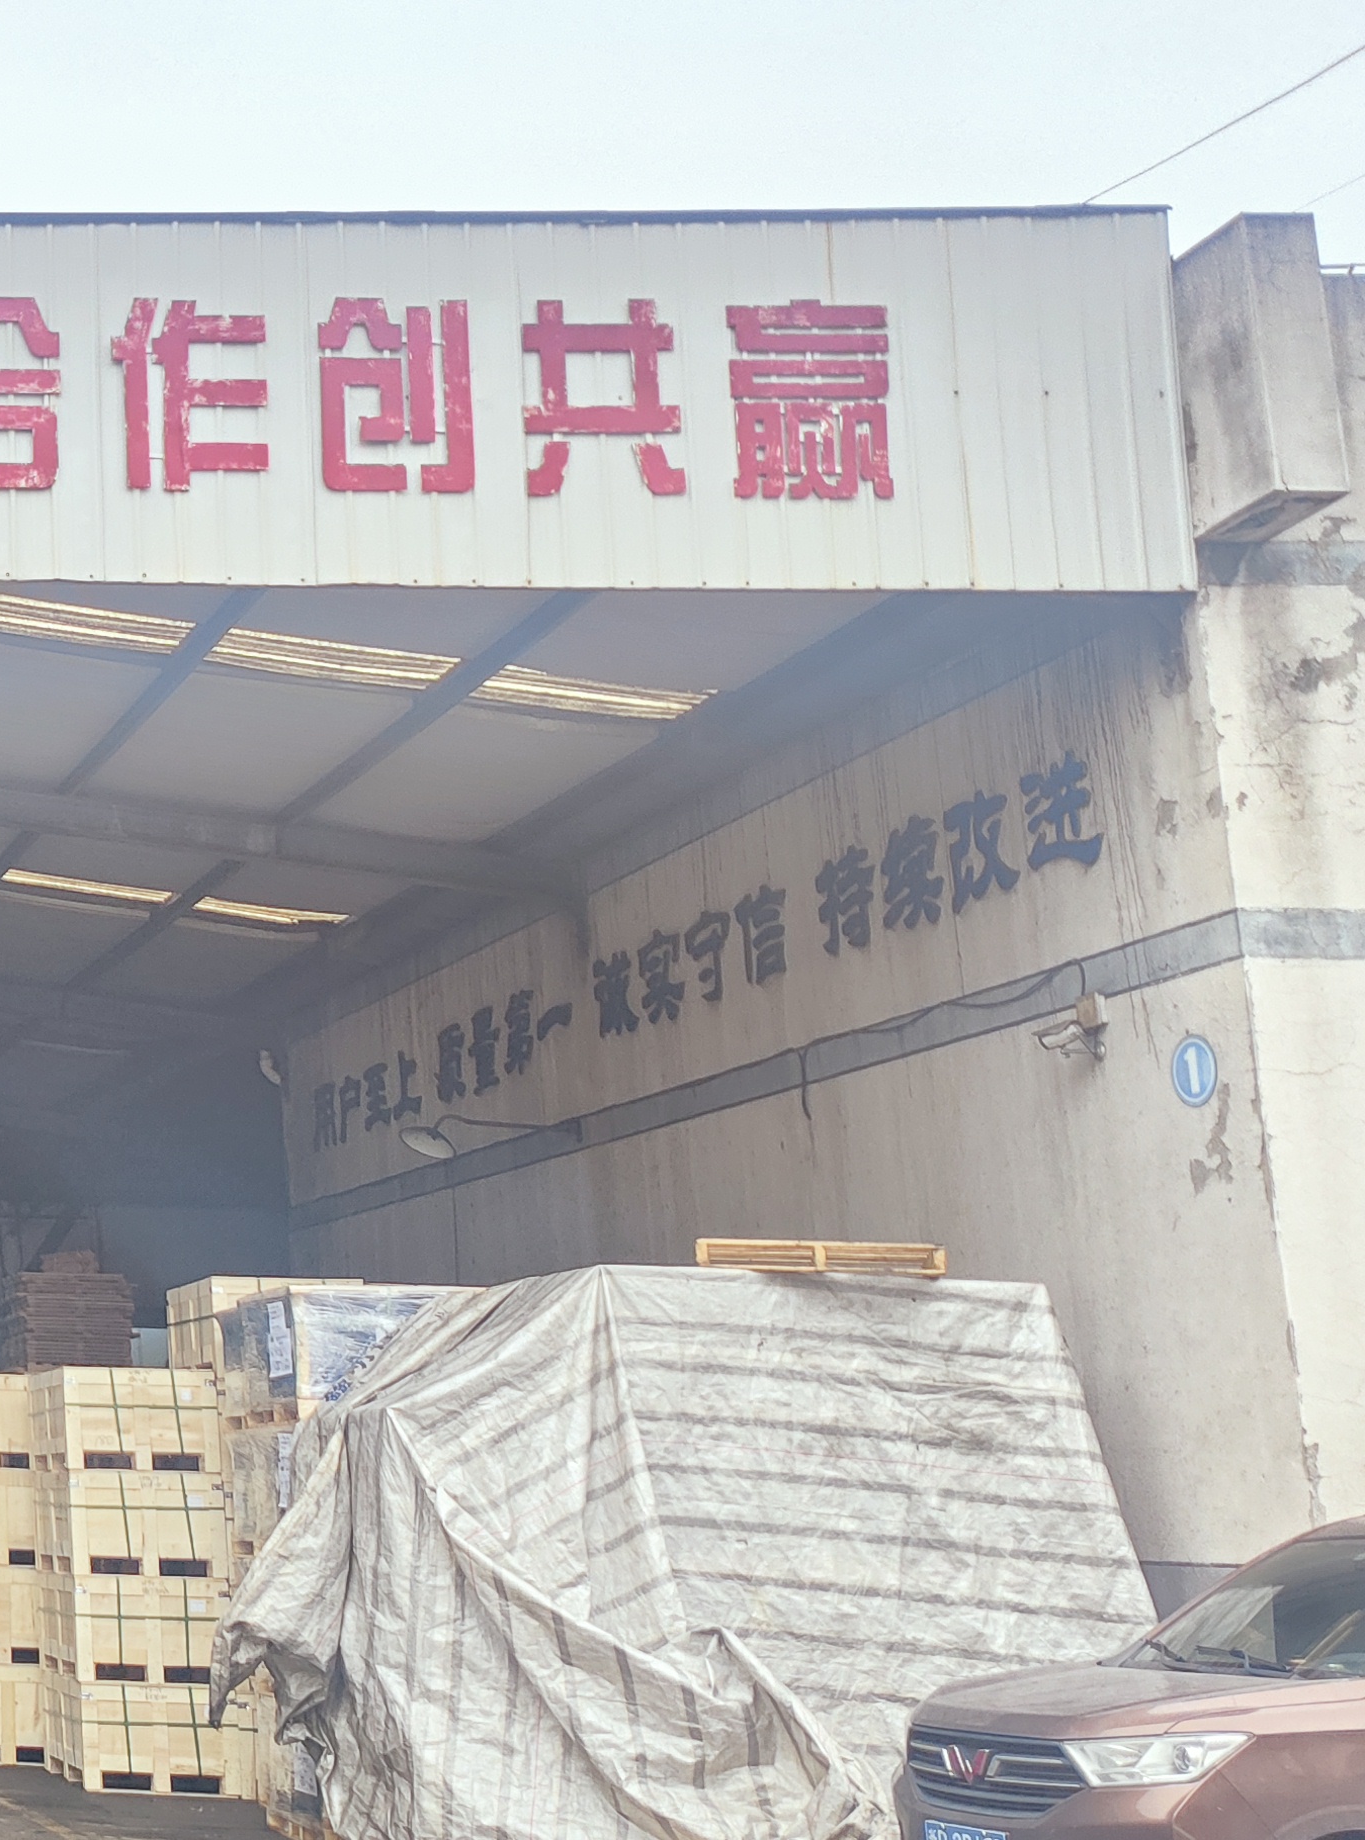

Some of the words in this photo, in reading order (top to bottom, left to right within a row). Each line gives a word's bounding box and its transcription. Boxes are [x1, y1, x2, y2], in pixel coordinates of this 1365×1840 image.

[314, 1050, 423, 1152] 用户至上
[434, 990, 573, 1103] 质量第一
[592, 884, 787, 1039] 诚实守信
[815, 749, 1105, 957] 持续改进
[1183, 1046, 1201, 1094] 1
